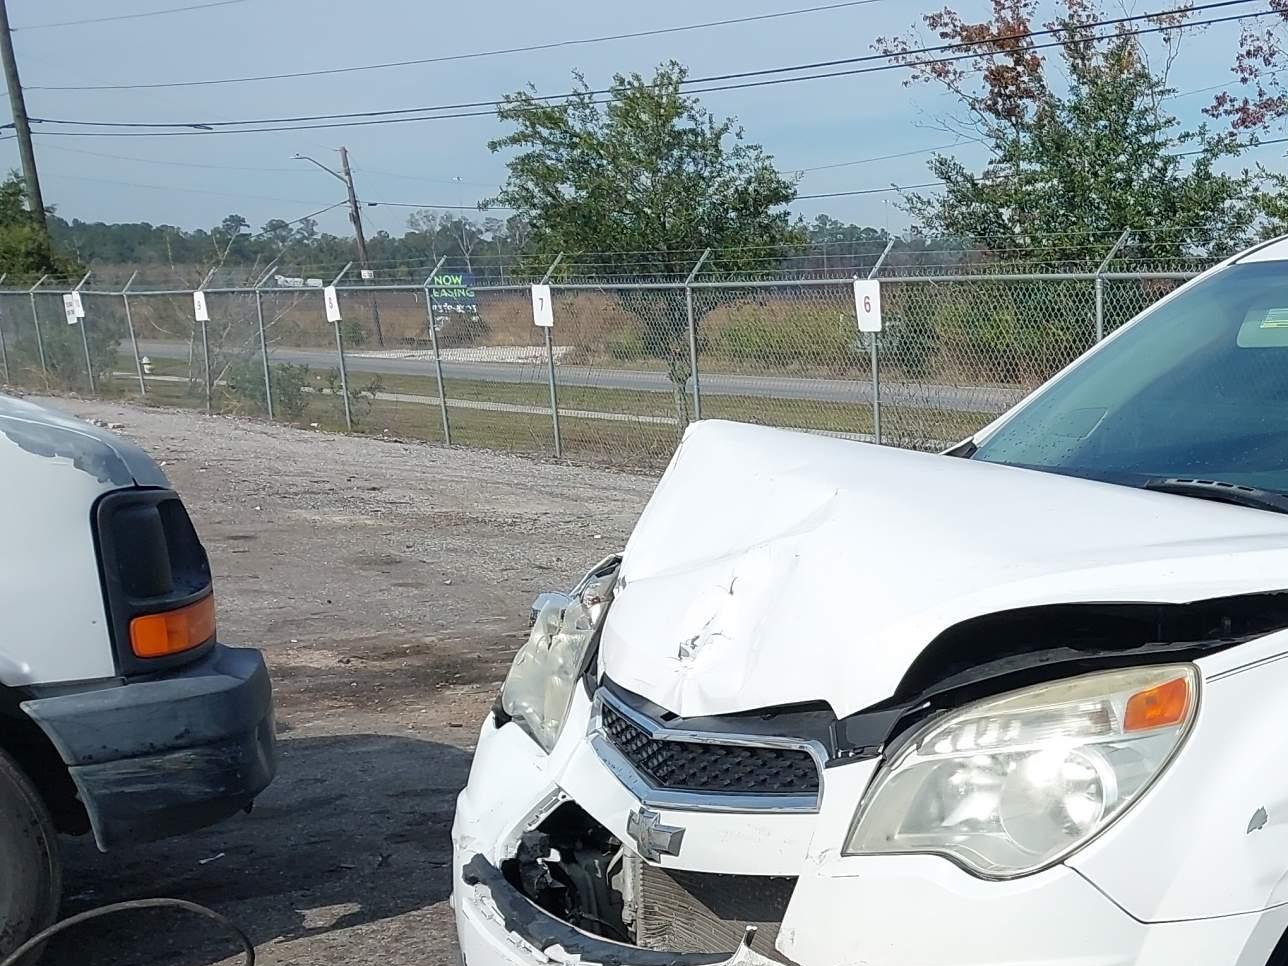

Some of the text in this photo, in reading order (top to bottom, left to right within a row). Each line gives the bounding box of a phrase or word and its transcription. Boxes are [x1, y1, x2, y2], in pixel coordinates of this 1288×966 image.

[434, 274, 463, 285] NOW
[432, 288, 475, 298] EASING
[538, 297, 544, 312] 7
[863, 295, 873, 313] 6
